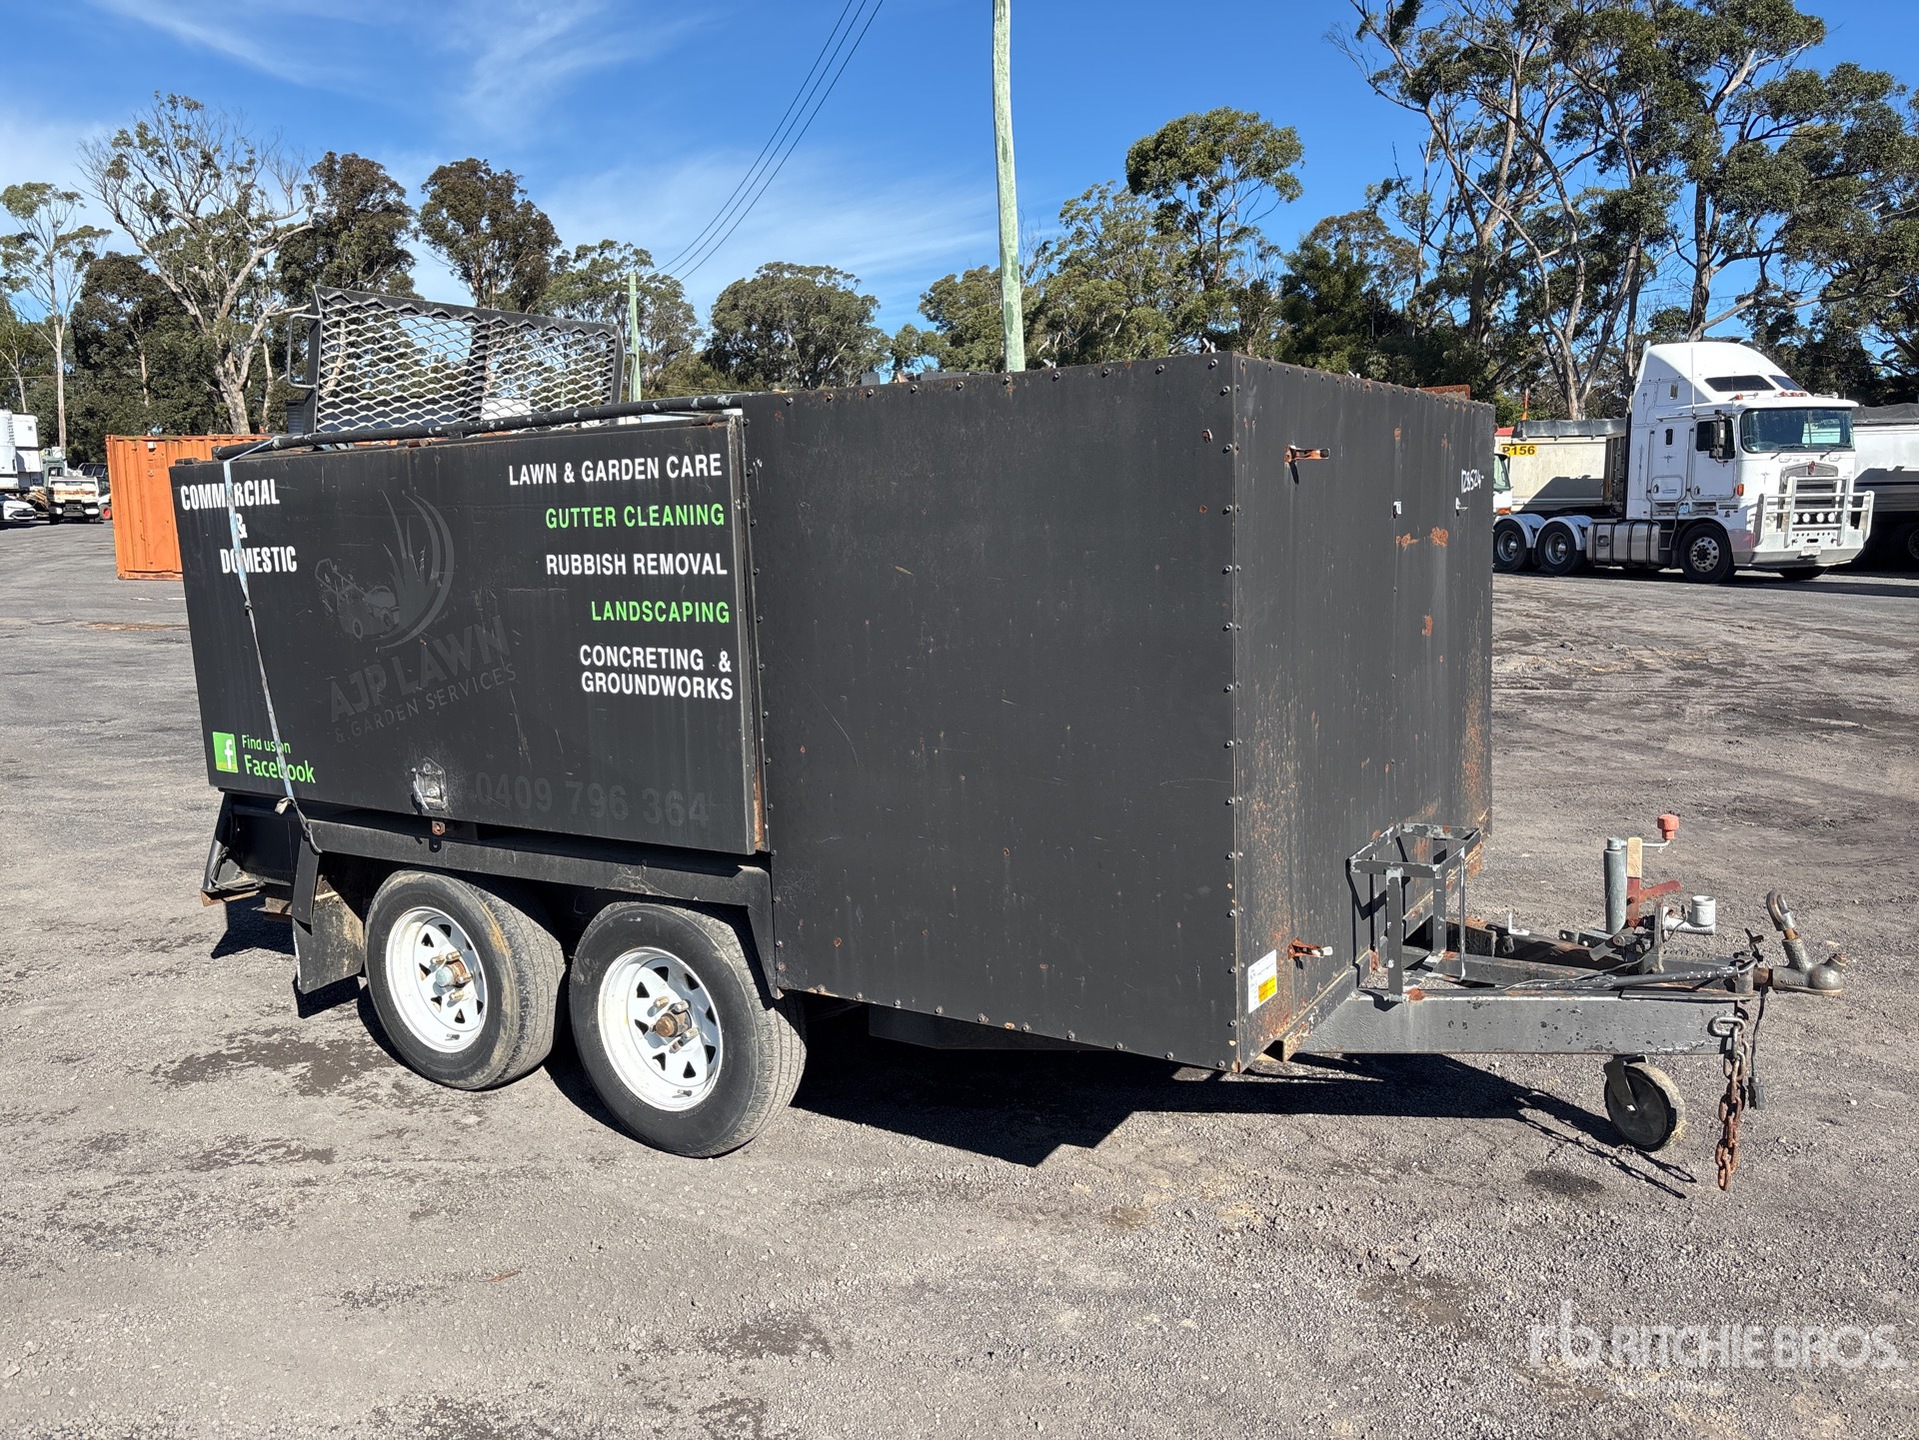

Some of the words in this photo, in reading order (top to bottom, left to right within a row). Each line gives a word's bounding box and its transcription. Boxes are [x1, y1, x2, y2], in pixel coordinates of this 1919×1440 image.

[509, 463, 557, 486] LAWN
[563, 462, 575, 483] &
[581, 457, 660, 483] GARDEN
[666, 453, 722, 478] CARE
[180, 479, 280, 511] COMMRCIAL
[545, 506, 617, 528] GUTTER
[623, 503, 725, 527] CLEANING
[546, 554, 627, 575] RUBBISH
[633, 553, 728, 575] REMOVAL
[591, 601, 730, 623] LANDSCAPING
[331, 664, 387, 723] AJP
[391, 615, 511, 696] LAWN
[579, 645, 704, 670] CONCRETING
[718, 651, 732, 672] &
[581, 671, 734, 700] GROUNDWORKS
[351, 698, 419, 738] GARDEN
[425, 663, 517, 710] SERVICES
[241, 734, 262, 751] Find
[264, 740, 276, 752] us
[475, 771, 552, 813] 0409
[565, 780, 630, 822] 796
[642, 787, 710, 828] 364
